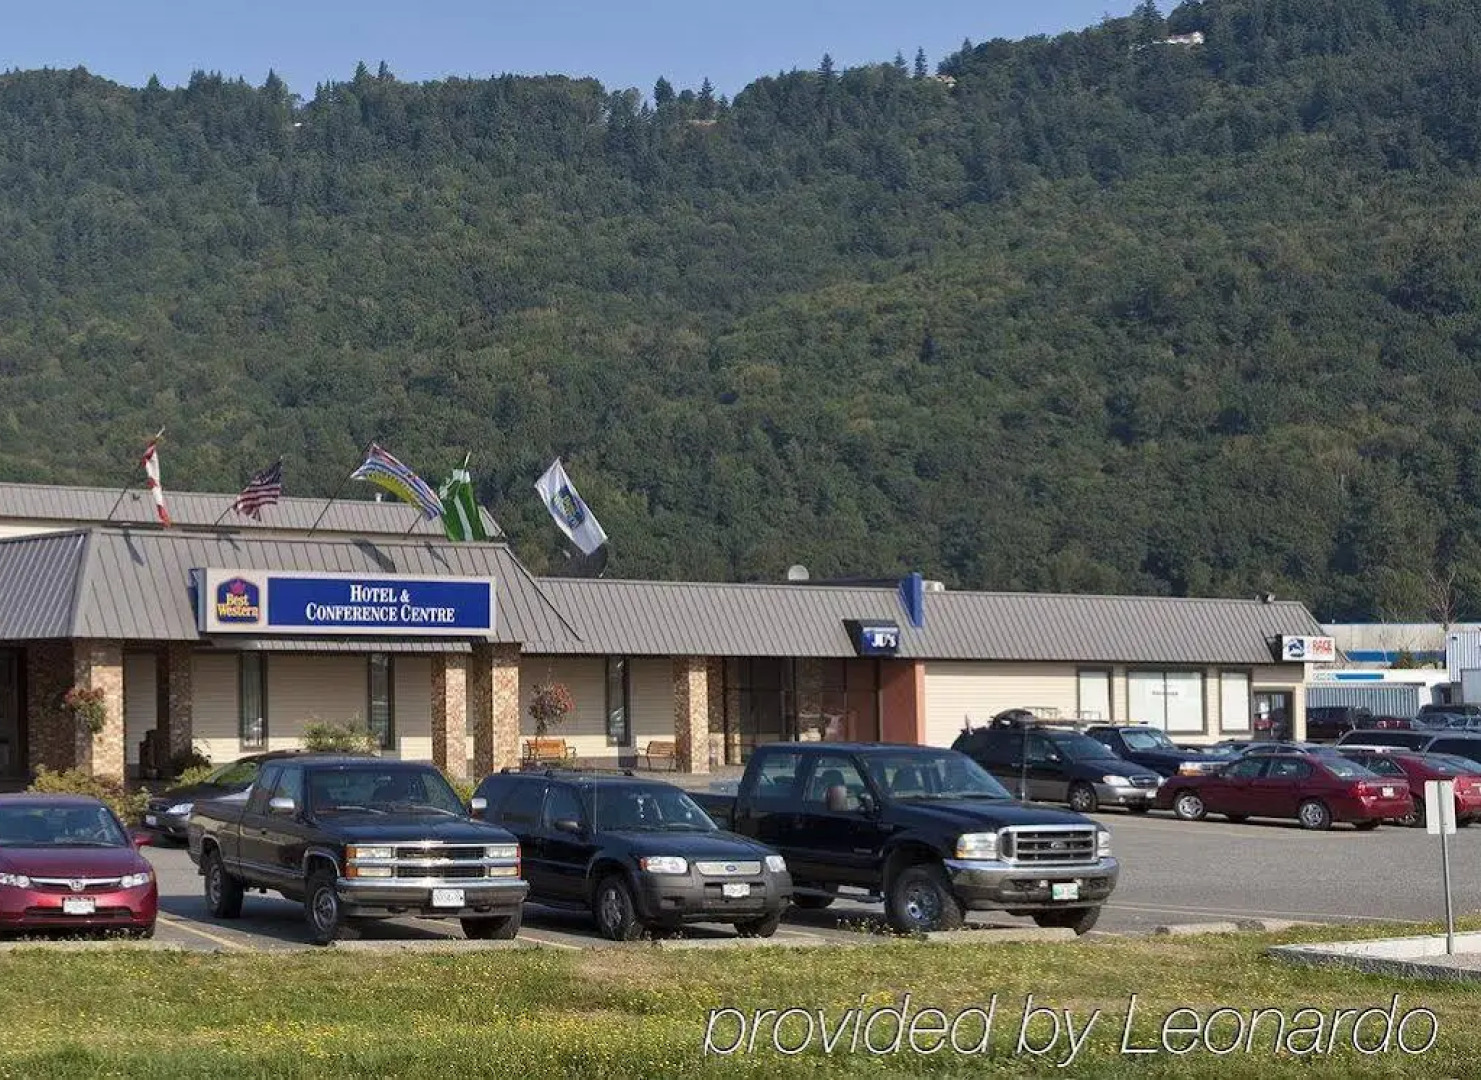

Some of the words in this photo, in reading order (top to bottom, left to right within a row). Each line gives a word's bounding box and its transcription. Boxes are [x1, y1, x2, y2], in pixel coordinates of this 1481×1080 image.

[226, 593, 249, 606] Best
[350, 584, 397, 603] HOTEL
[399, 588, 411, 603] &
[217, 604, 259, 617] Western
[306, 602, 397, 622] CONFERENCE
[400, 603, 456, 623] CENTRE
